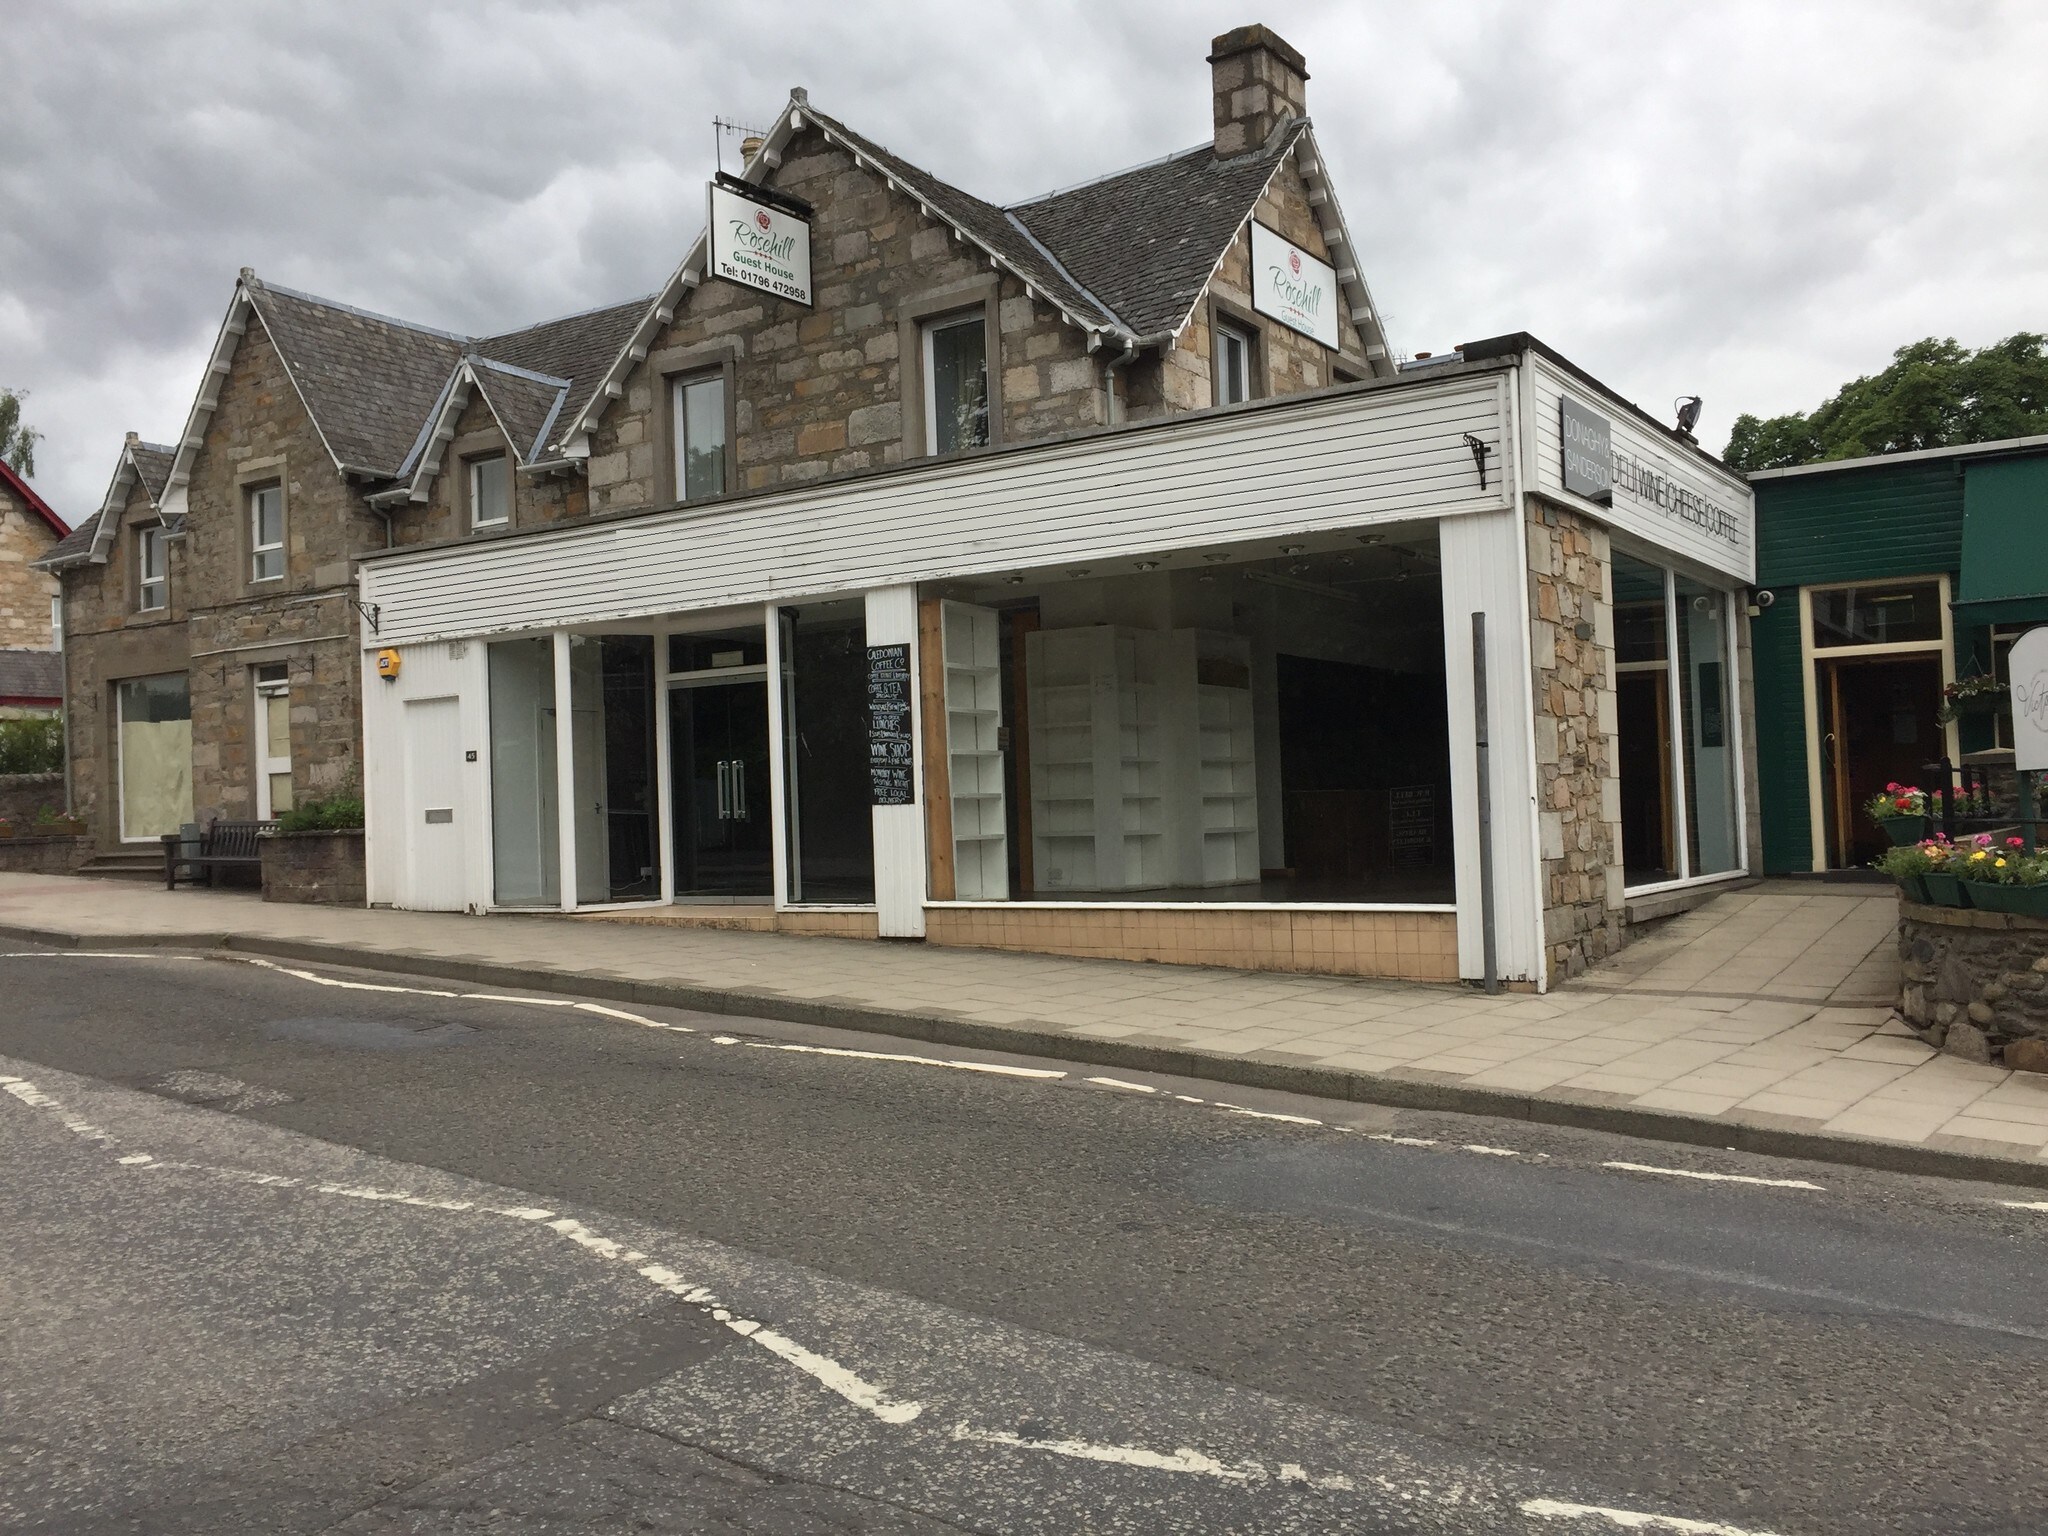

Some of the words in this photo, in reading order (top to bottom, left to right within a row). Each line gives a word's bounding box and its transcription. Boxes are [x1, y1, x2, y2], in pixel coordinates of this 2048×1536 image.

[729, 220, 796, 261] Rosehill
[733, 251, 762, 270] Guest
[764, 262, 794, 281] House
[721, 262, 738, 277] Tel:
[741, 269, 770, 288] 01796
[772, 281, 806, 300] 472958
[1269, 265, 1322, 317] Rosehill
[1566, 448, 1611, 488] SANDERSON
[866, 647, 903, 660] CALEDONIAN
[871, 659, 894, 671] COFFEE
[888, 682, 903, 694] TEA
[872, 719, 901, 732] LUNCHES
[870, 743, 889, 756] WINE
[889, 742, 911, 757] SHOP
[873, 788, 888, 798] FREE
[890, 789, 910, 799] LOCAL
[878, 796, 905, 804] DELIVERY
